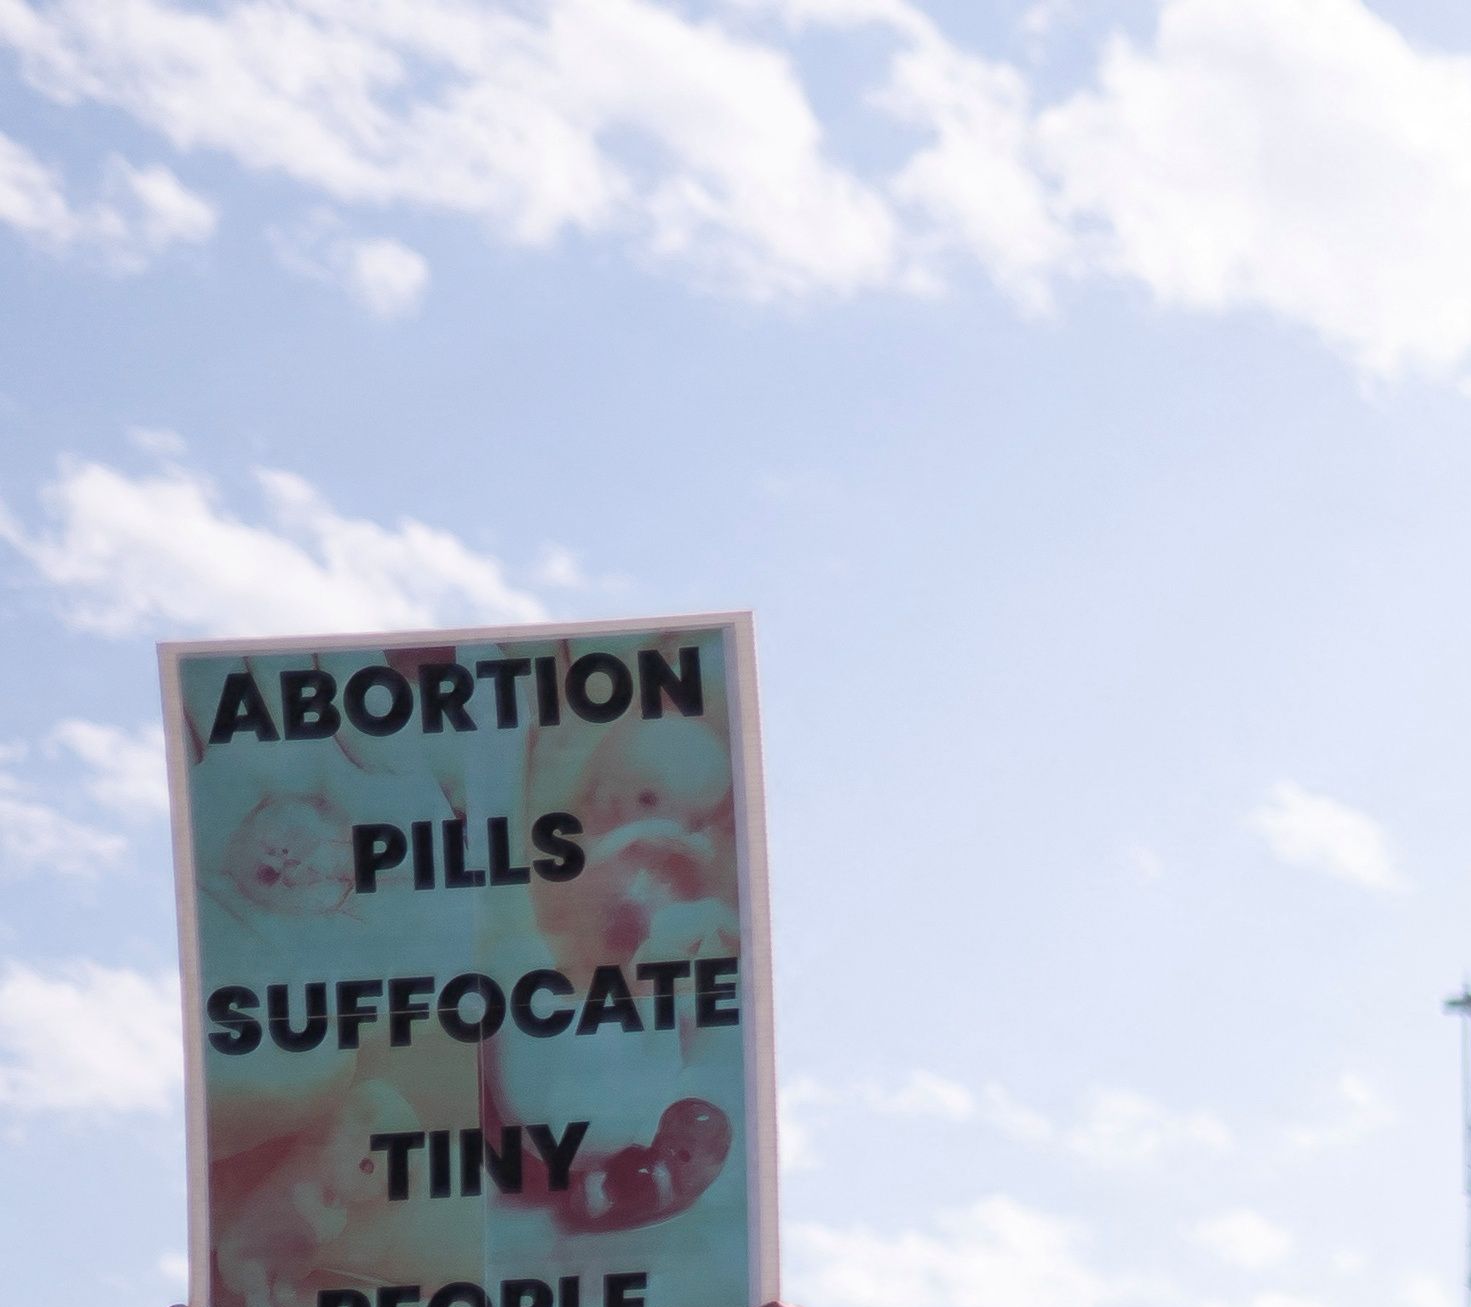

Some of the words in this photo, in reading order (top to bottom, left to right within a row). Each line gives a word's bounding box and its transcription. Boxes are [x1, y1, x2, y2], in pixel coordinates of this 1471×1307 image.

[209, 646, 704, 745] ABORTION
[352, 811, 587, 895] PILLS
[206, 957, 741, 1056] SUFFOCATE
[370, 1120, 591, 1202] TINY
